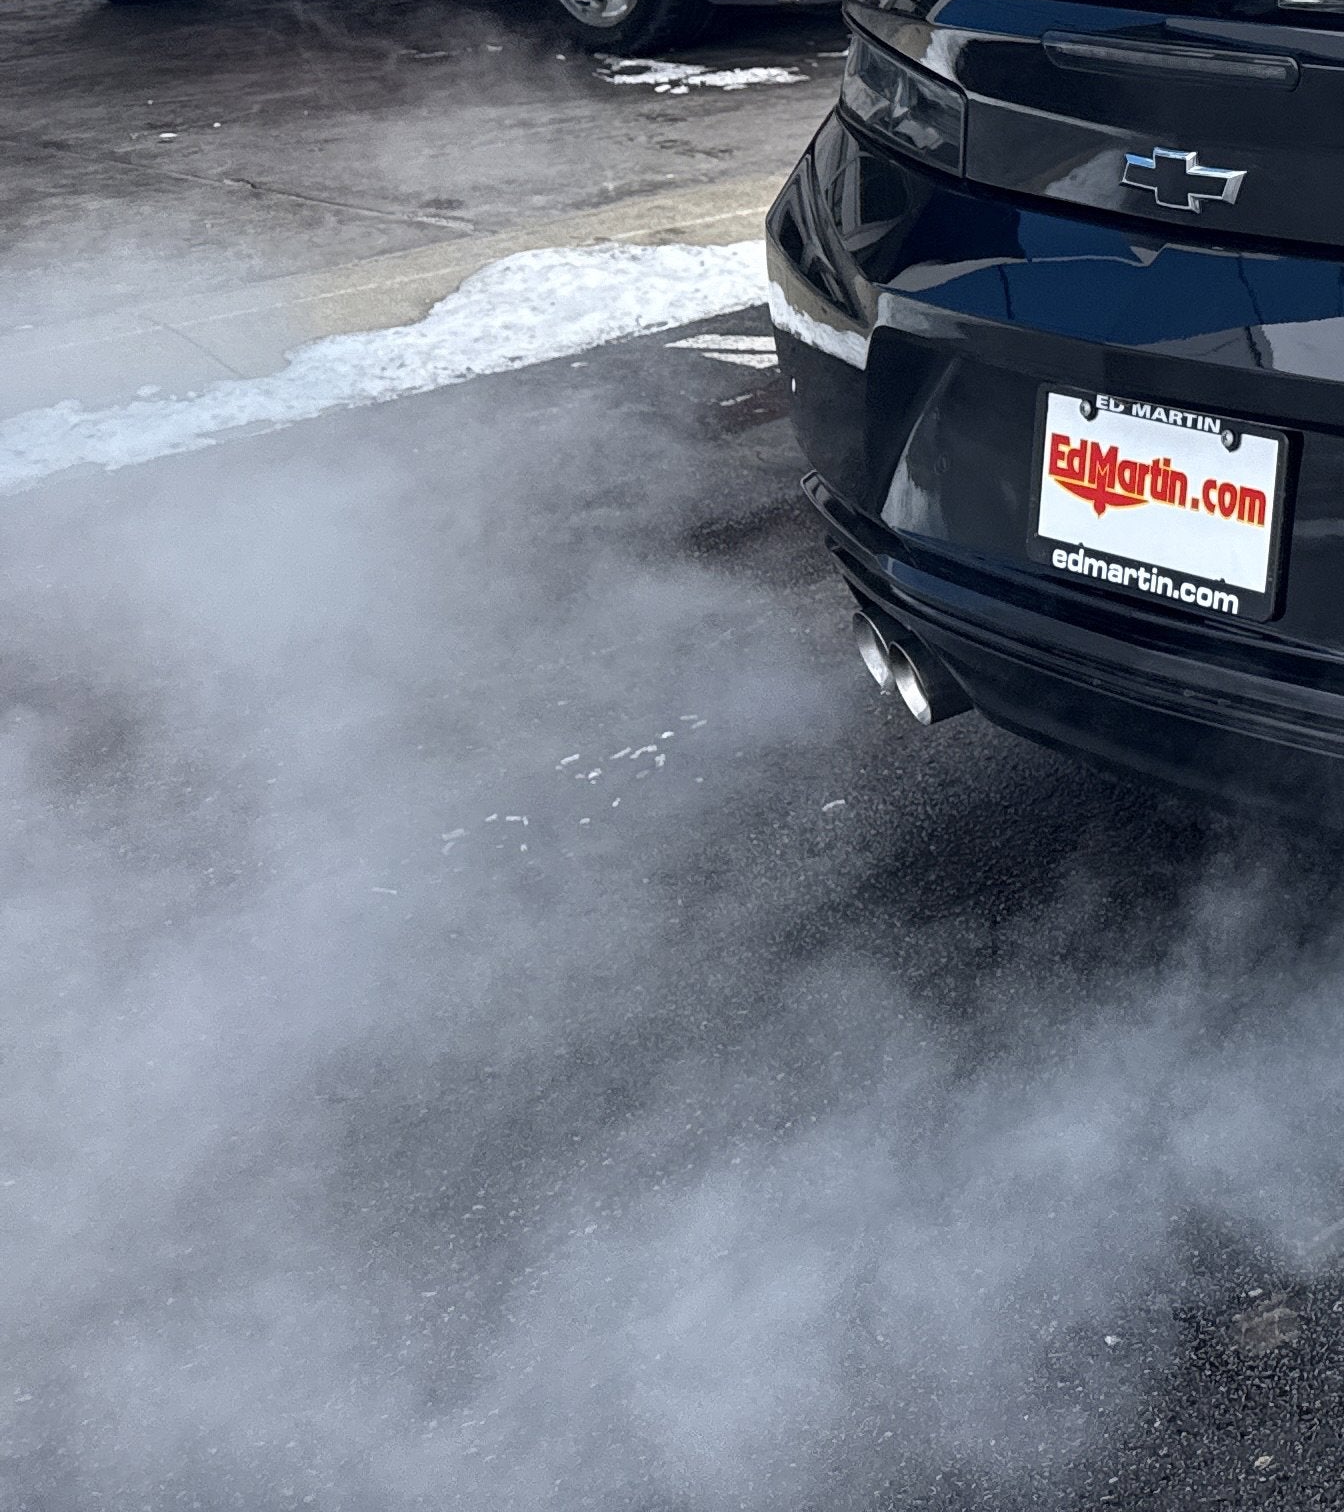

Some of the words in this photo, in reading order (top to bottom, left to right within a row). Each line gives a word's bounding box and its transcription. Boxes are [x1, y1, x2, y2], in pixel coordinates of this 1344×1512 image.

[1096, 394, 1124, 411] ED
[1131, 402, 1221, 433] MARTIN
[1052, 547, 1240, 614] edmartin.com
